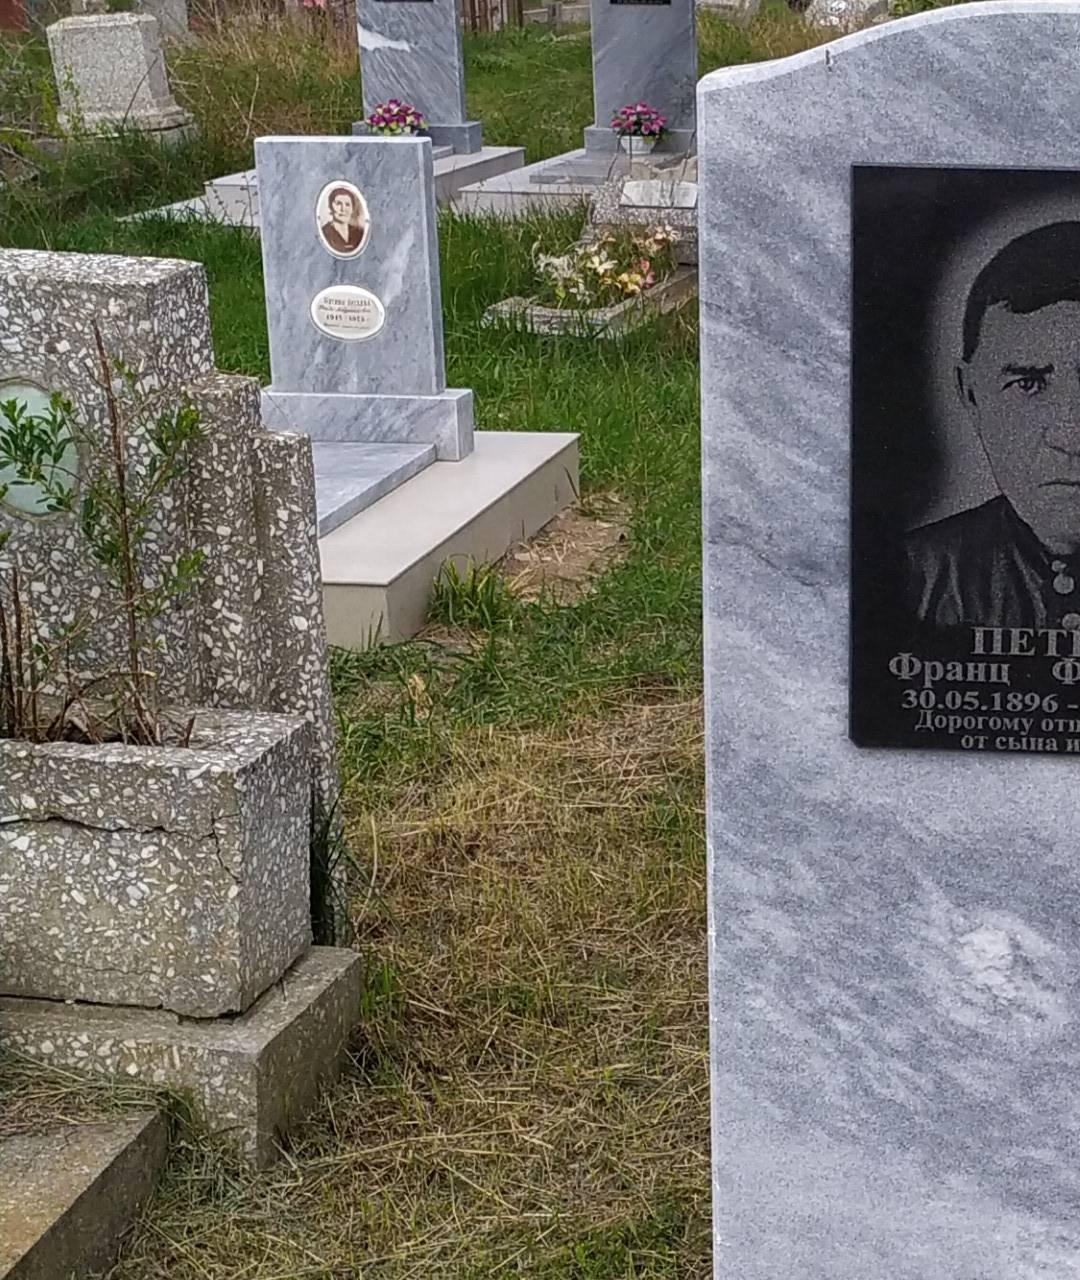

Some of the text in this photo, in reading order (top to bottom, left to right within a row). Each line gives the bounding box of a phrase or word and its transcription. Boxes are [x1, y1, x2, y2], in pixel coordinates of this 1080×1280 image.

[888, 652, 1011, 689] Франц
[901, 689, 1059, 713] 30.05.1896
[913, 709, 1034, 736] Дорогому
[960, 735, 989, 750] от
[995, 736, 1059, 752] сына
[1065, 738, 1080, 753] и
